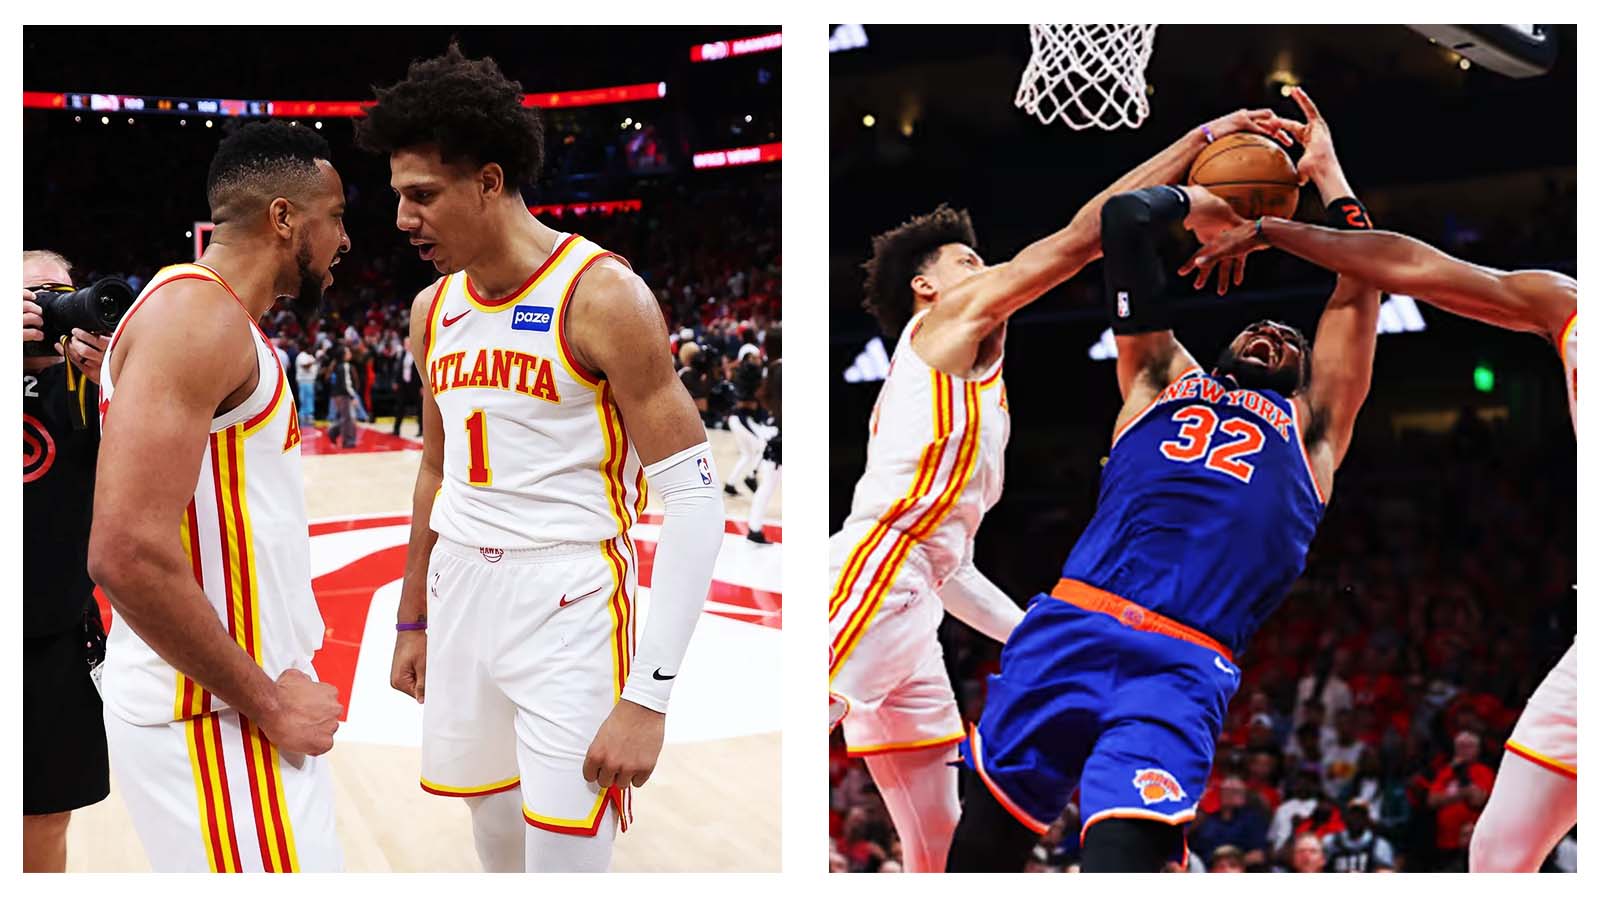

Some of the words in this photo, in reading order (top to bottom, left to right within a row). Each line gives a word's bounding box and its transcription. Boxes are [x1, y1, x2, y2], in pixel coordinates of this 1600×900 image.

[514, 311, 550, 325] paze
[429, 349, 561, 405] ATLANTA
[1159, 377, 1226, 404] NEW
[1225, 389, 1293, 442] YORK
[464, 408, 492, 487] 1
[1159, 404, 1266, 484] 32
[480, 546, 505, 555] HAWKS
